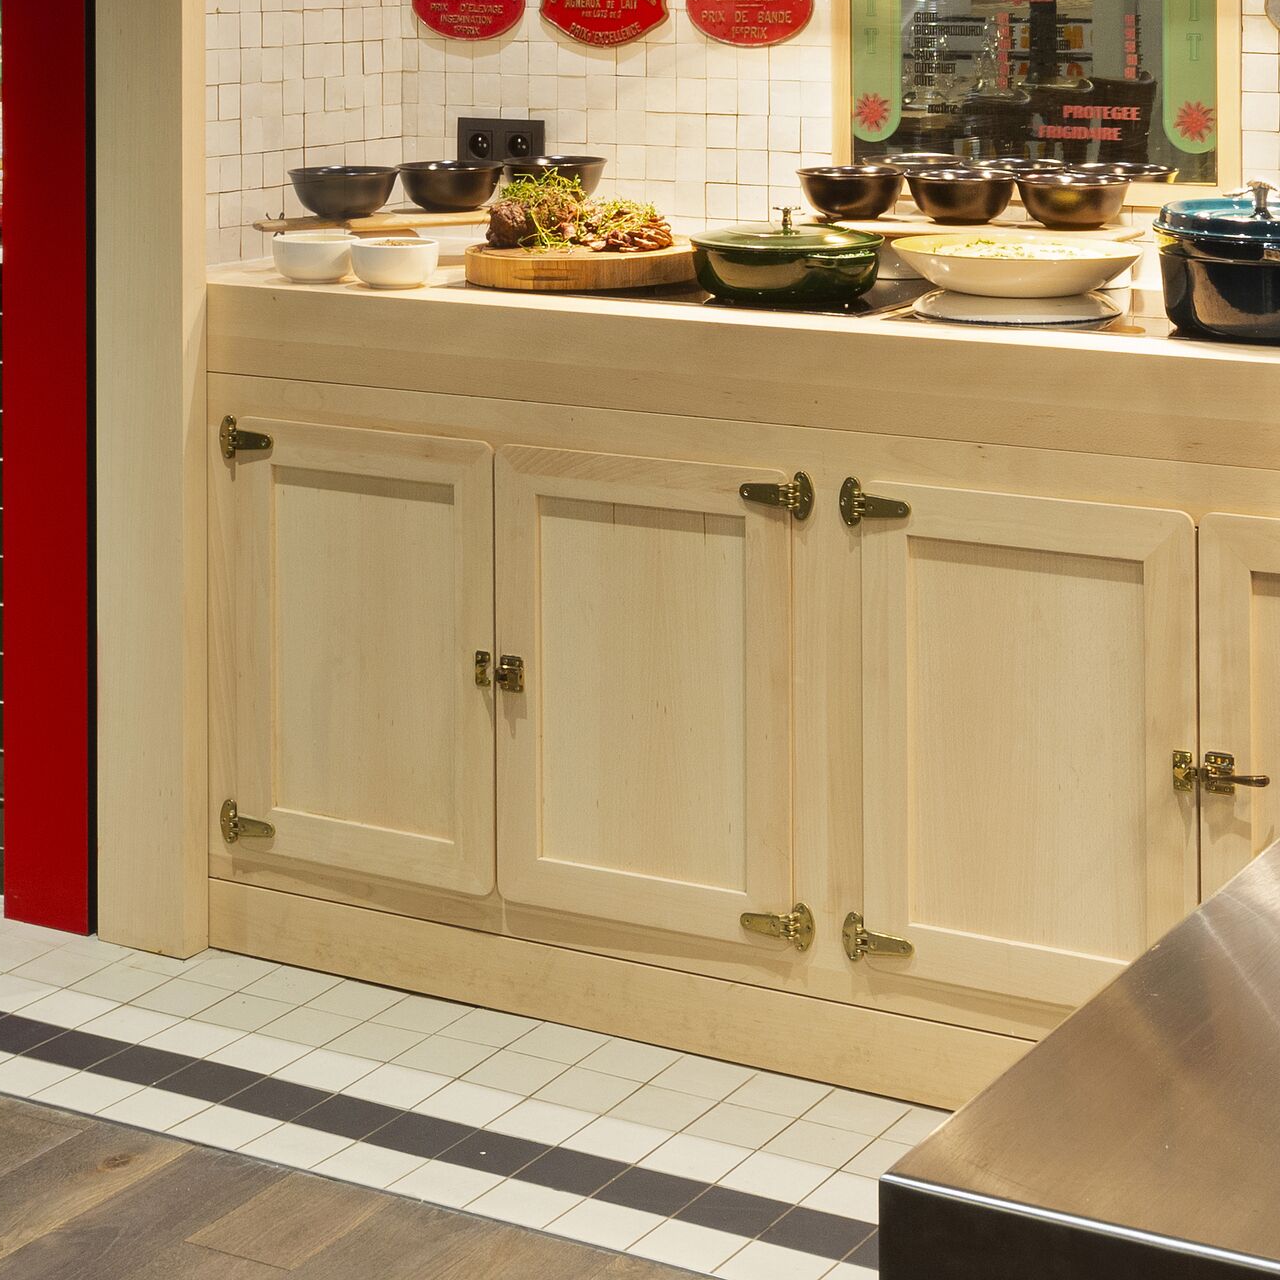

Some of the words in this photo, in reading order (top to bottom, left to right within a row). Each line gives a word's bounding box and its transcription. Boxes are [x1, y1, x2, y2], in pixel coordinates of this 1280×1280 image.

[701, 10, 725, 23] PRIX
[734, 10, 749, 23] DE
[758, 10, 793, 24] BANDE
[743, 26, 768, 40] PRIX
[1063, 105, 1141, 121] PROTEGEE
